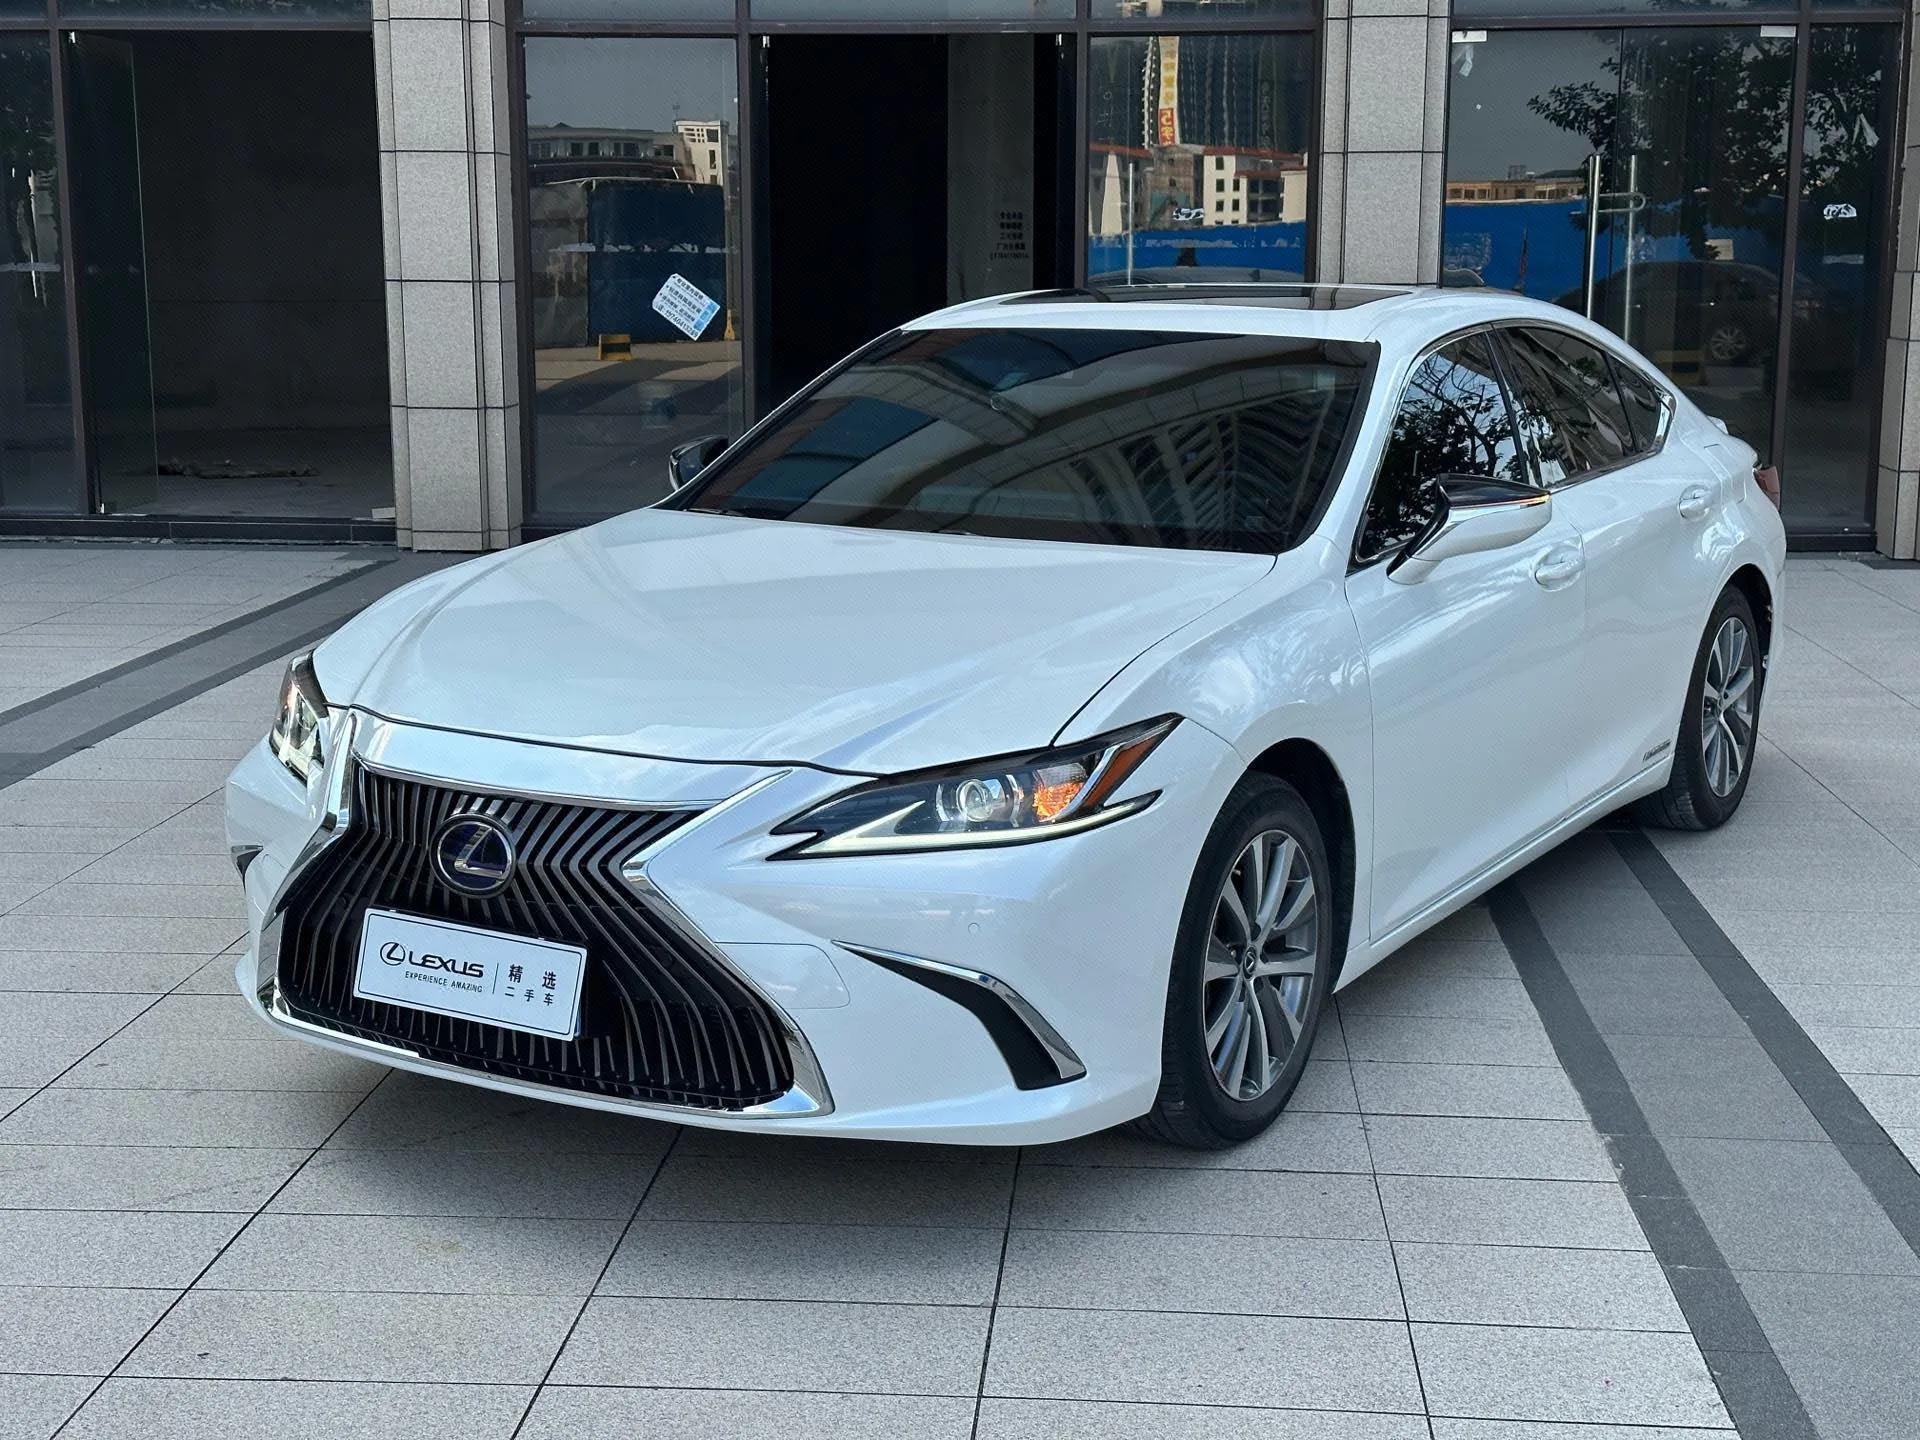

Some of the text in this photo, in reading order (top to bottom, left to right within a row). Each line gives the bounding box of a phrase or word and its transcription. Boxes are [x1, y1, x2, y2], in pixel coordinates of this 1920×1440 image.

[408, 951, 484, 978] LEXUS
[404, 970, 483, 993] EXPERIENCE AMAZING
